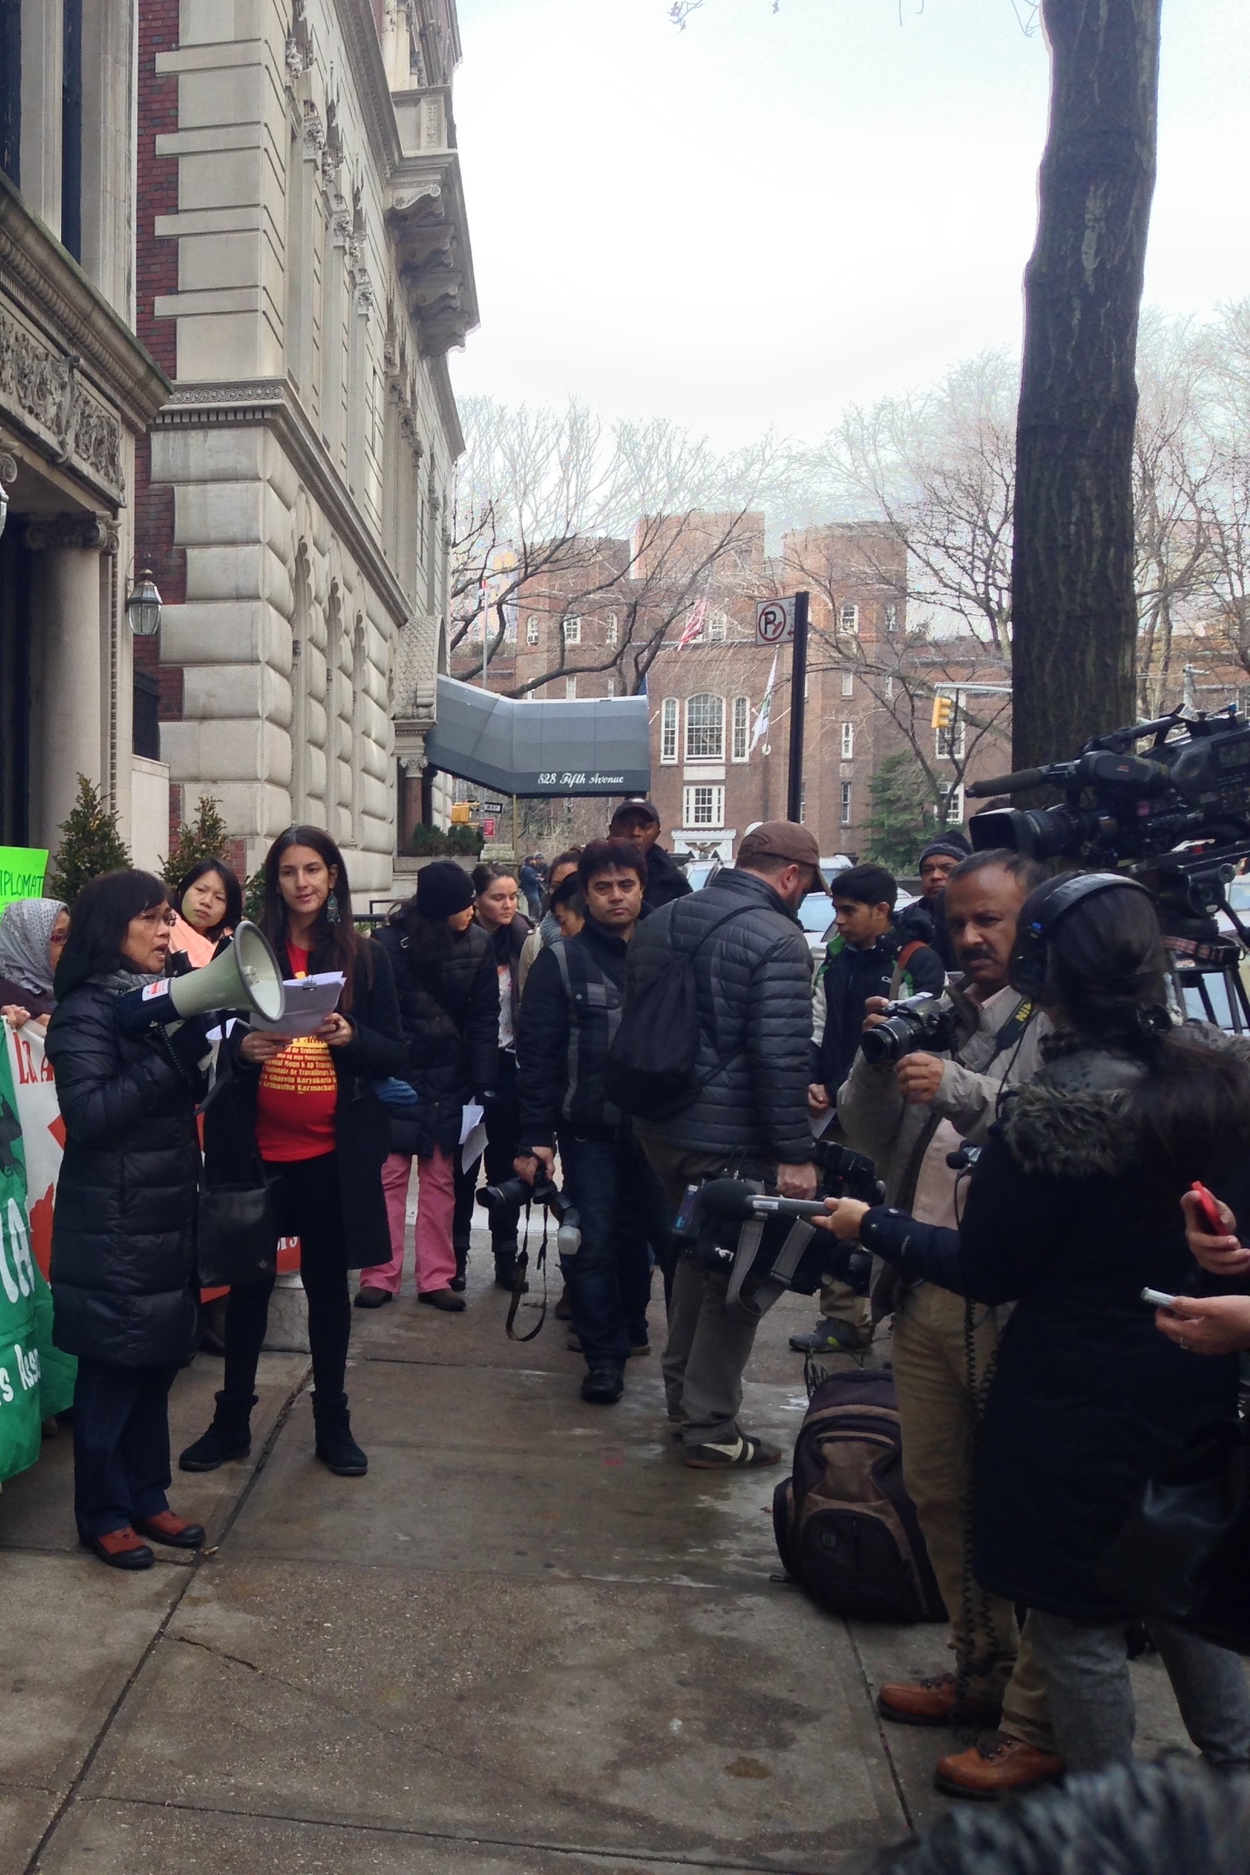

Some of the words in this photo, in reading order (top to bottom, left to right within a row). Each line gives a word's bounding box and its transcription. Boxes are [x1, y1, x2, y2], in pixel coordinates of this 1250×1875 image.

[537, 773, 557, 784] 828
[559, 772, 586, 788] Fifth
[588, 773, 625, 784] Avenue
